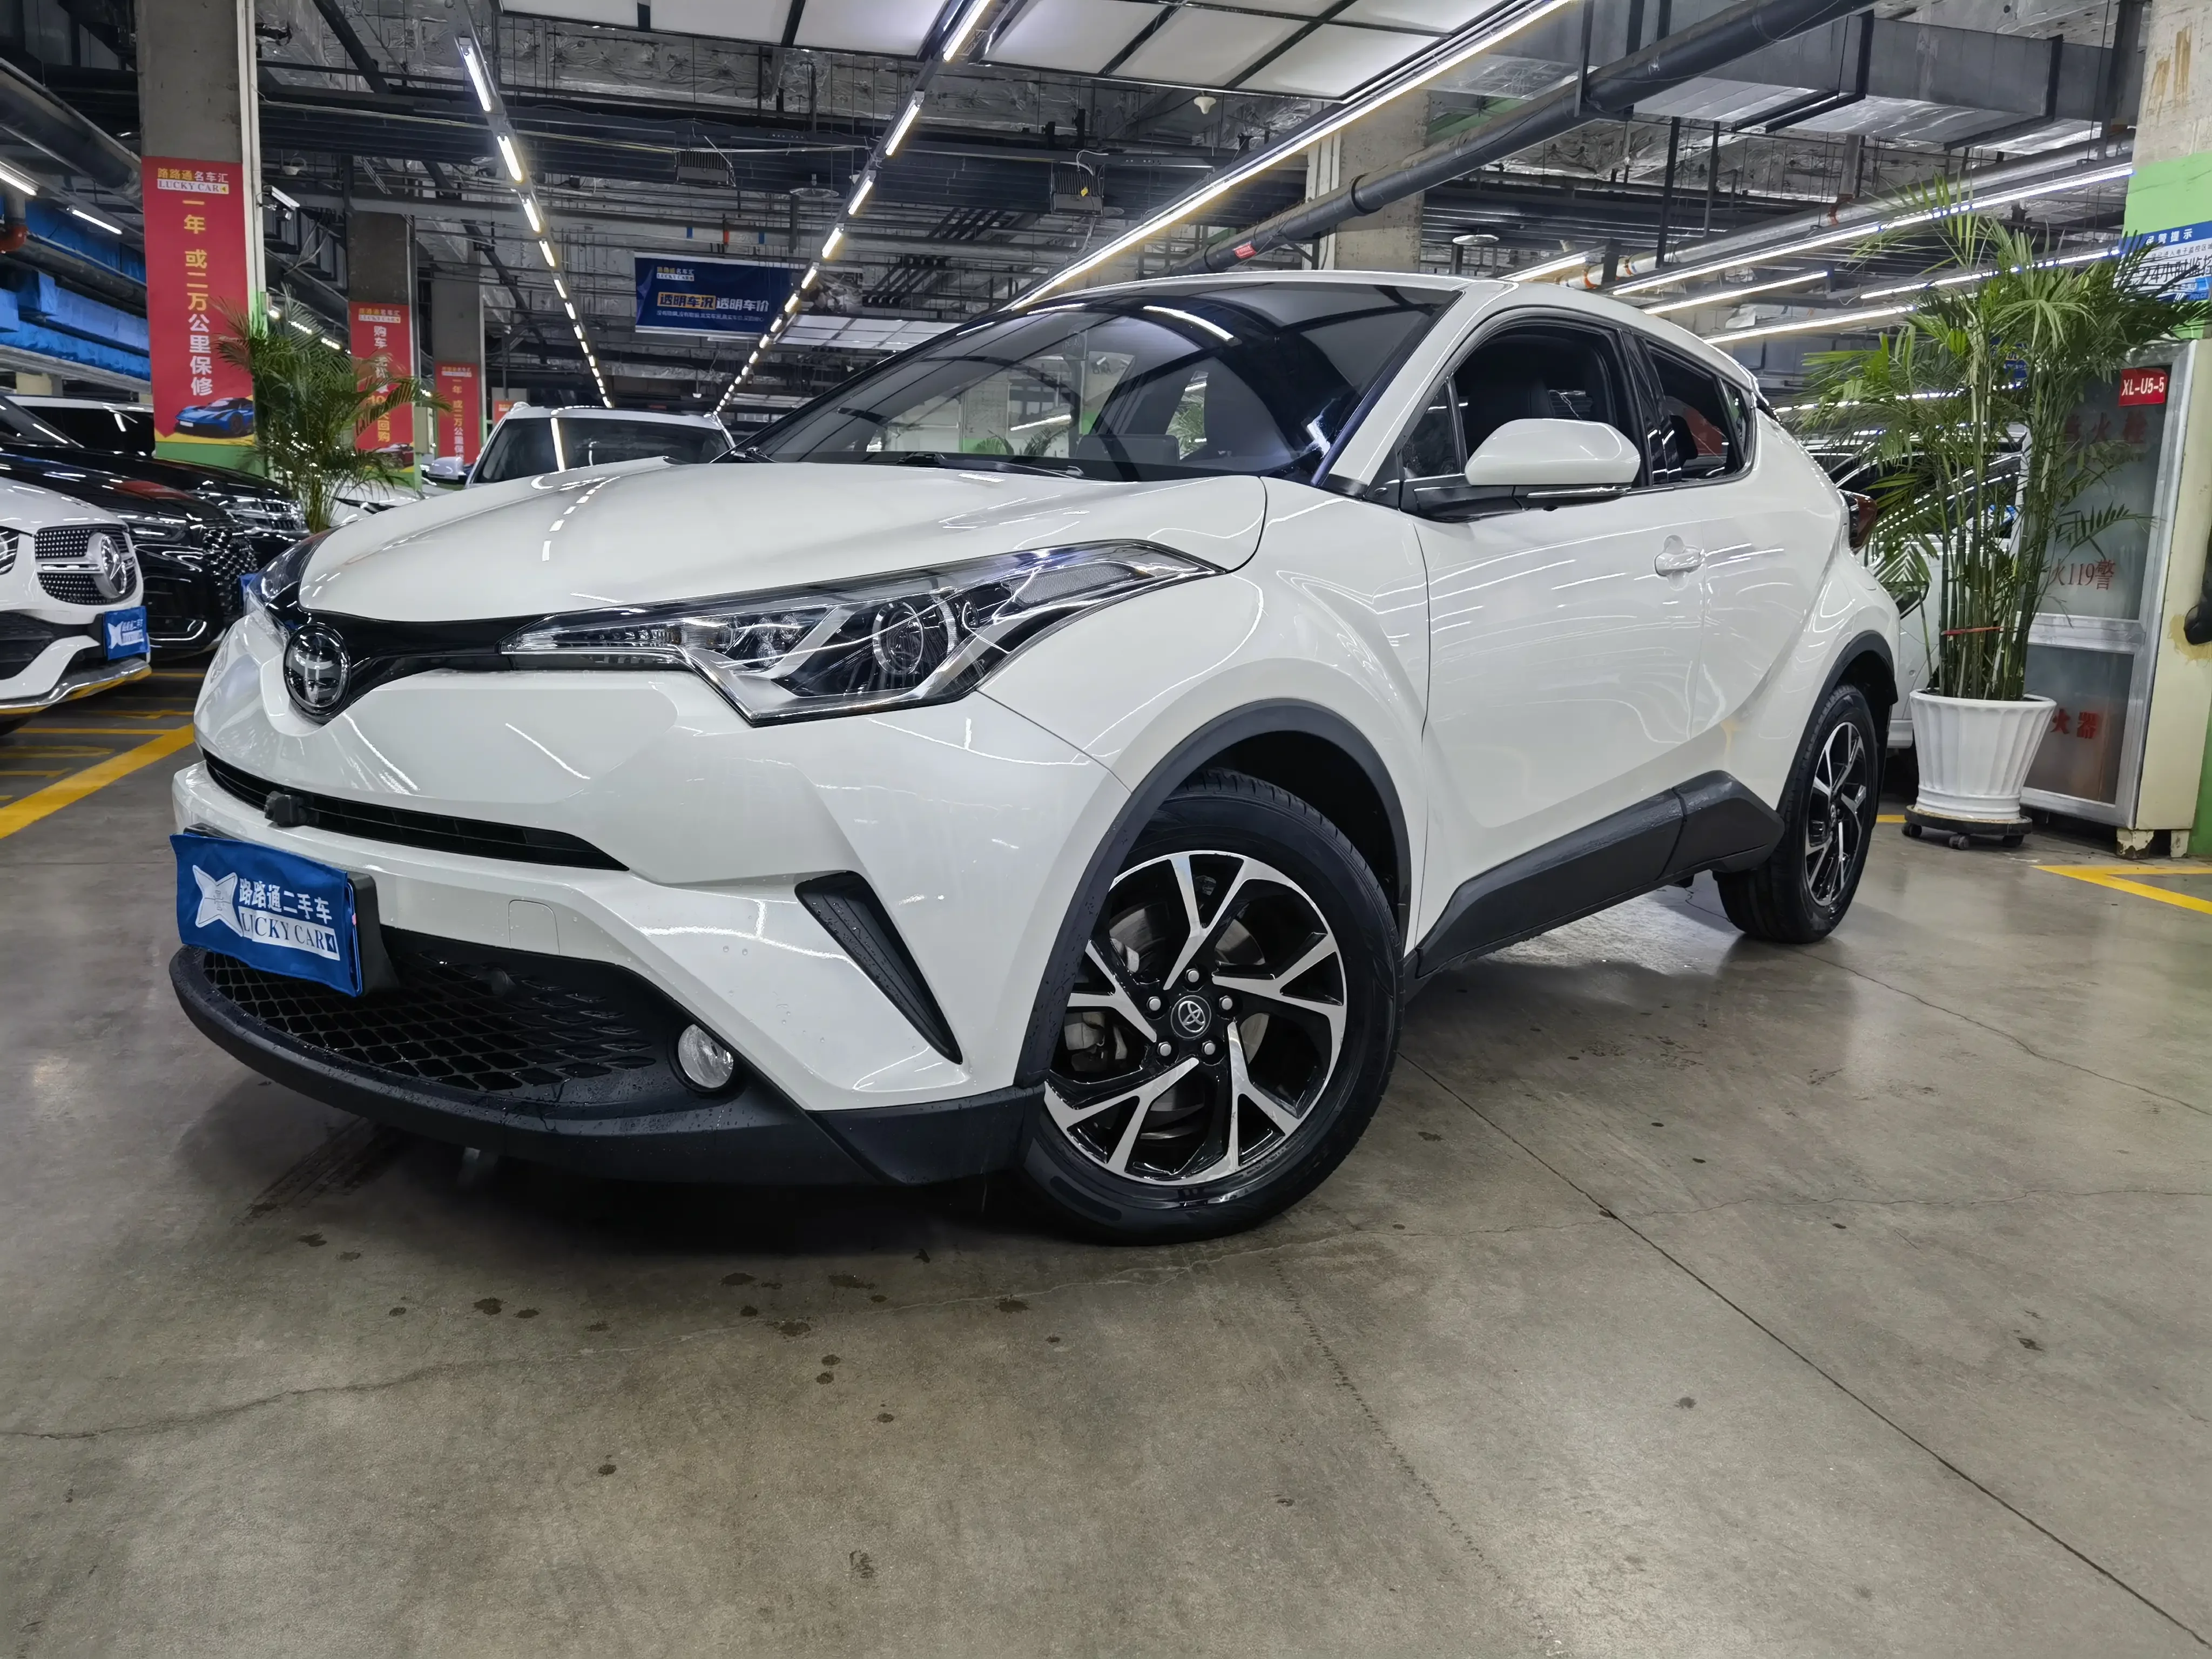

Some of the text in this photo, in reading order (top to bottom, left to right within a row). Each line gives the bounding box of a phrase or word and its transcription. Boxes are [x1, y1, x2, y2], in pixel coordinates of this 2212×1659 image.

[159, 180, 220, 192] LUCKY CAR
[659, 293, 769, 312] 透明车况 透明车价
[2122, 376, 2164, 395] XL-U5-5
[239, 878, 333, 924] 路路通二手车
[294, 924, 326, 950] CAR
